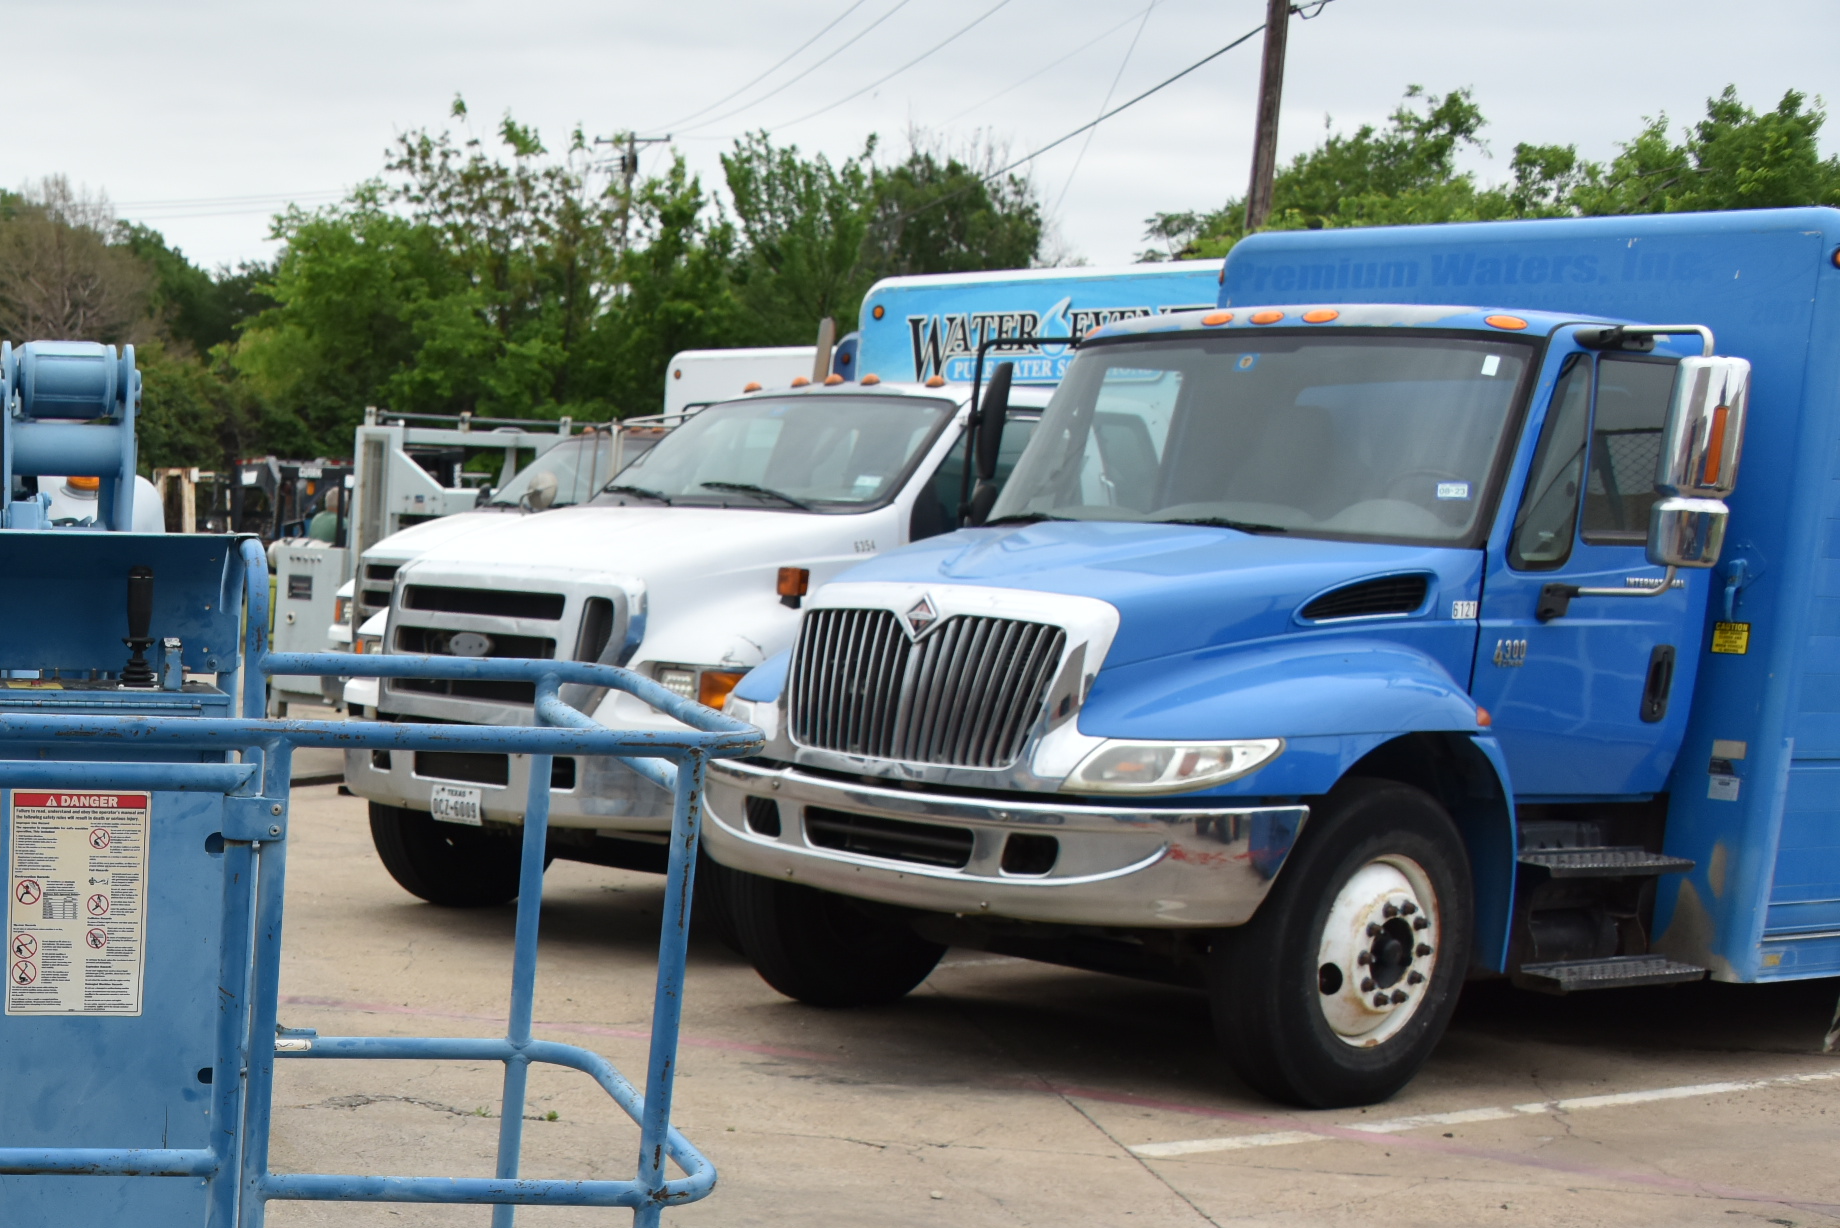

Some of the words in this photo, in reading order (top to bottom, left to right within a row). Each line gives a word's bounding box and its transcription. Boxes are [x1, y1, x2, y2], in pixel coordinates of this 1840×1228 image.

[1232, 258, 1420, 294] Premium
[1430, 251, 1610, 288] Waters,
[908, 313, 1040, 384] WATER
[954, 361, 995, 378] PUE
[1452, 602, 1477, 618] 6121
[1716, 622, 1749, 631] CAUTION
[1493, 639, 1528, 666] 4300
[61, 795, 119, 808] DANGER
[448, 789, 466, 798] TEXAS
